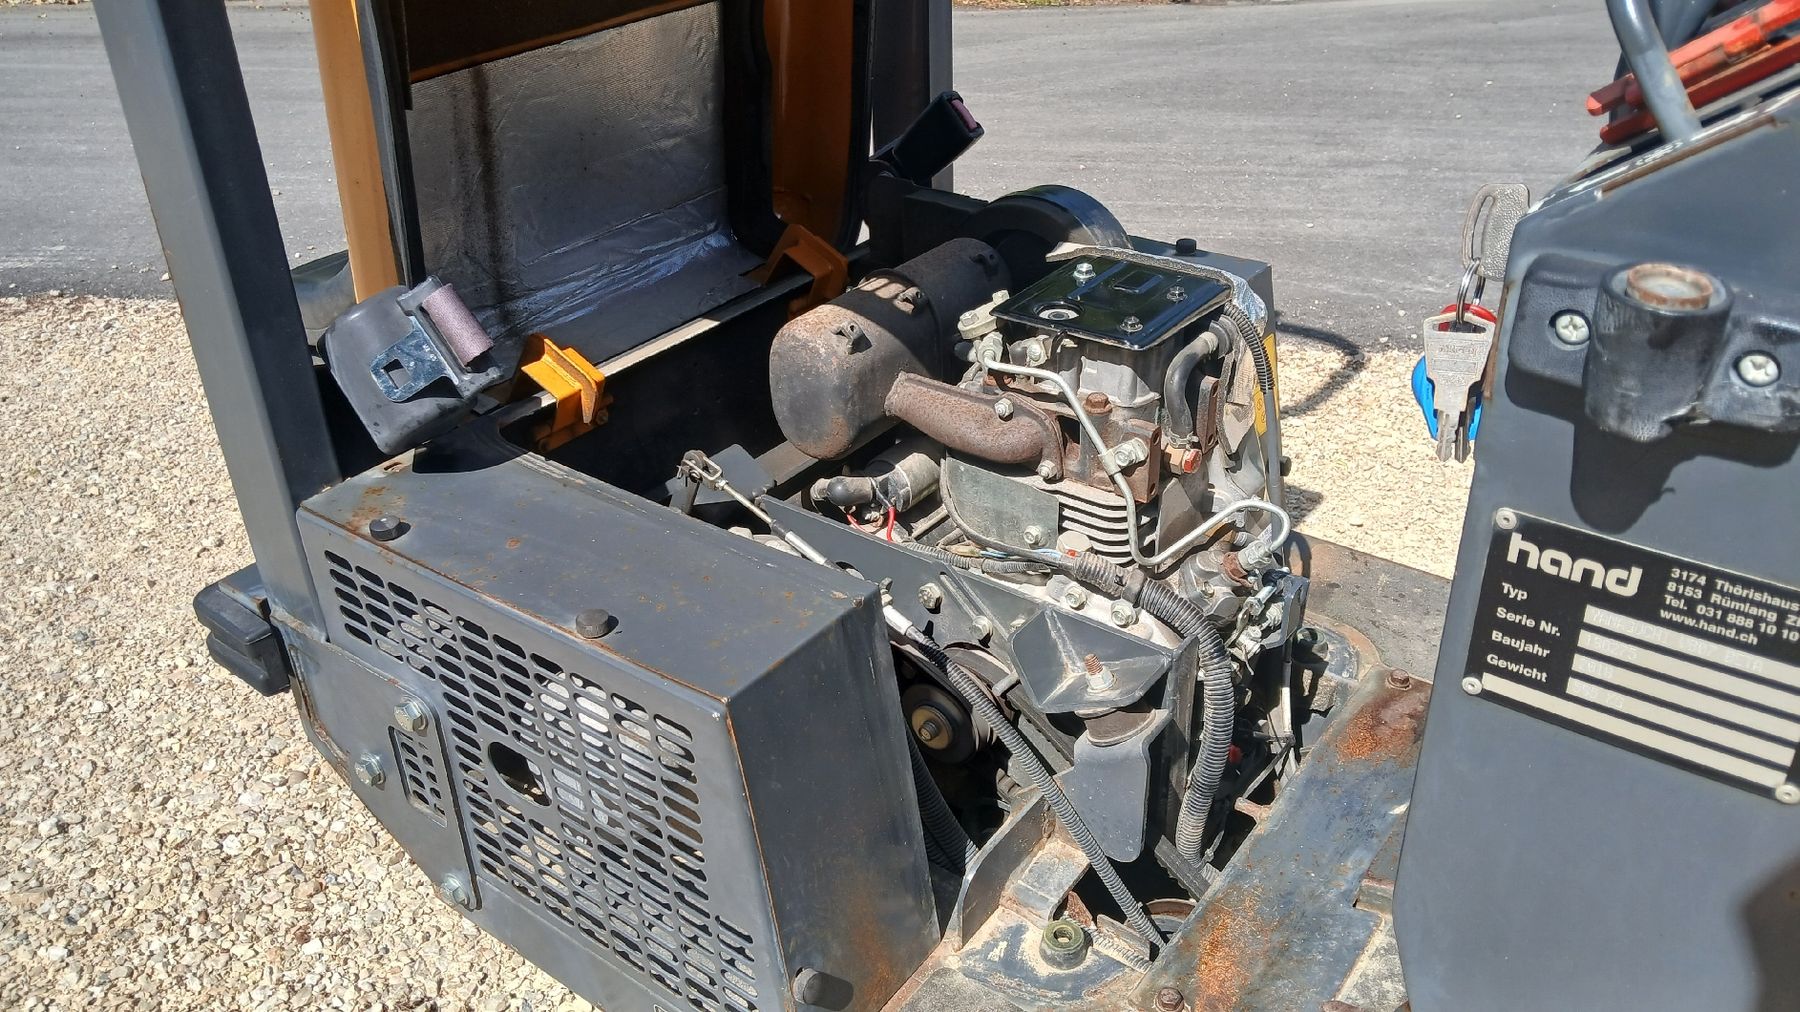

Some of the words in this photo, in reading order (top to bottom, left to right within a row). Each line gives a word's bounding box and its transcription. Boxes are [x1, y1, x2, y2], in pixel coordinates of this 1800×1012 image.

[1507, 532, 1643, 597] hand
[1502, 582, 1528, 601] Typ
[1666, 582, 1702, 599] 8153
[1710, 593, 1777, 622] Rümlang
[1671, 568, 1706, 586] 3174
[1715, 579, 1800, 611] Thörishaus
[1496, 606, 1535, 628] Serie
[1540, 620, 1561, 637] Nr.
[1660, 609, 1758, 645] www.hand.ch
[1664, 595, 1687, 610] Tel.
[1696, 604, 1722, 620] 031
[1727, 613, 1754, 629] 888
[1759, 622, 1777, 635] 10
[1782, 629, 1800, 642] 10
[1491, 630, 1550, 658] Baujahr
[1486, 653, 1548, 683] Gewicht
